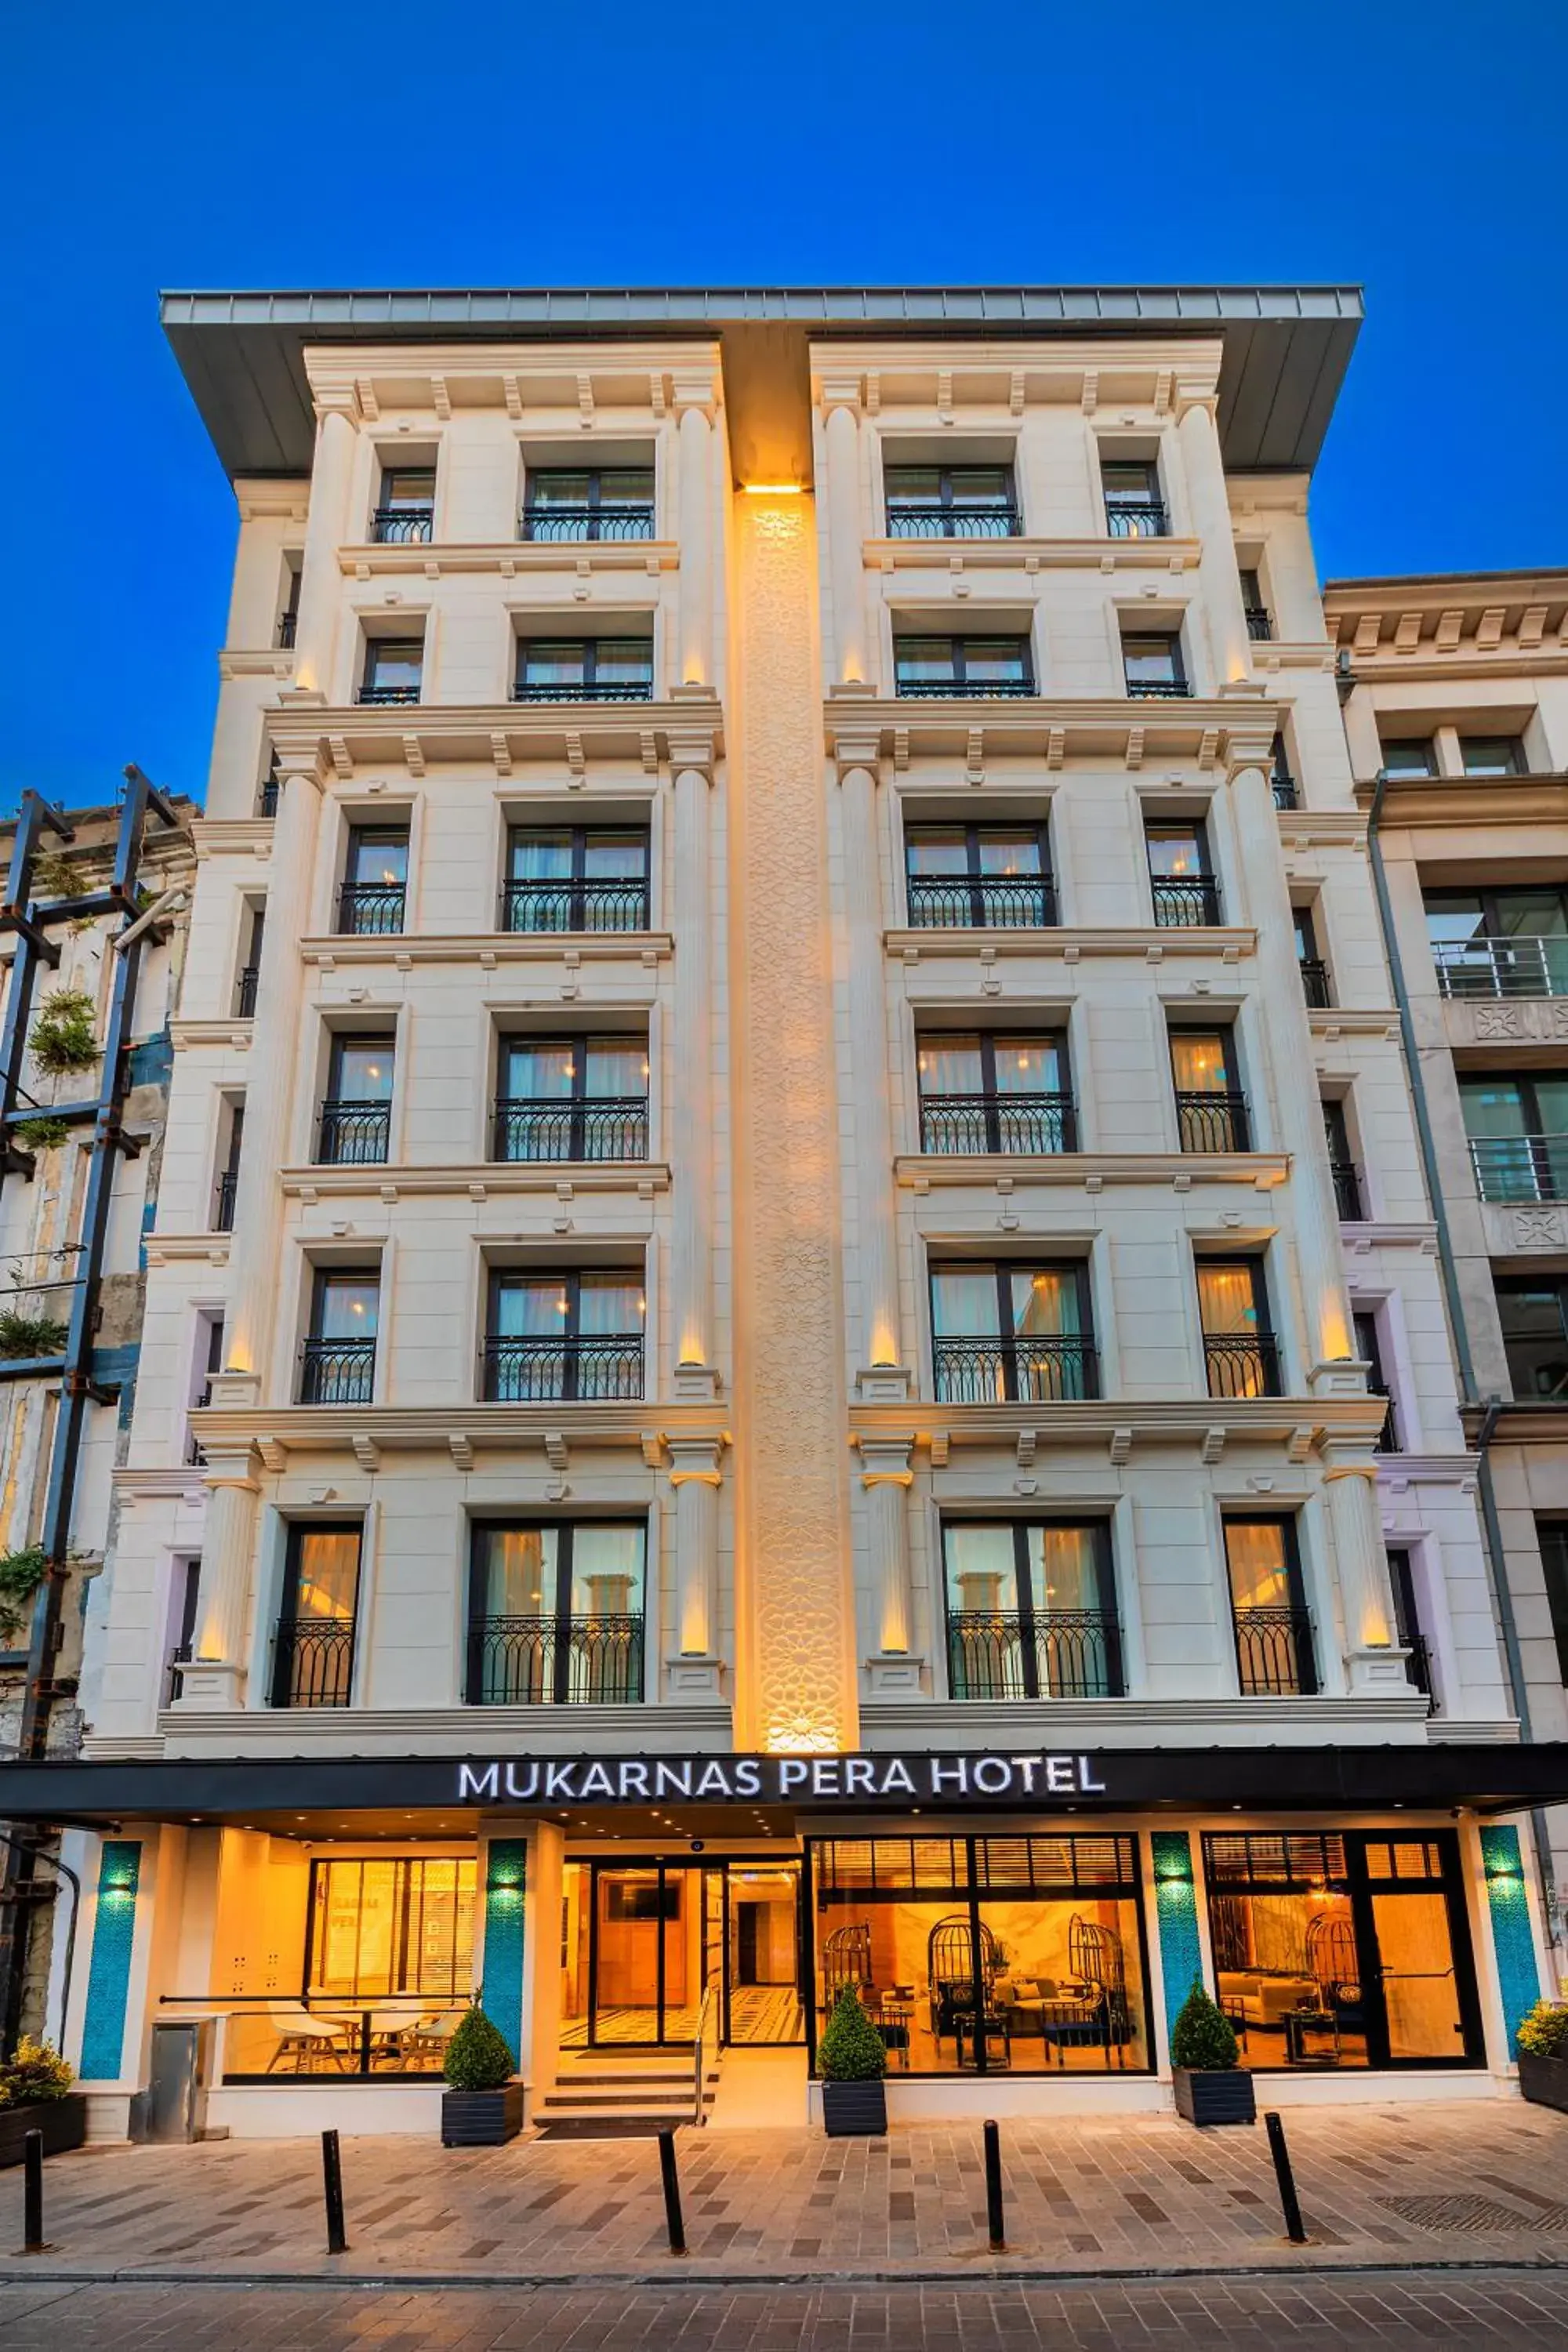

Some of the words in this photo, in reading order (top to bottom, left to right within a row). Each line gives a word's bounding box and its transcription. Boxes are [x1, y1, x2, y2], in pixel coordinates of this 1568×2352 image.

[459, 1760, 761, 1798] MUKARNAS
[779, 1759, 917, 1795] PERA
[931, 1755, 1106, 1793] HOTEL
